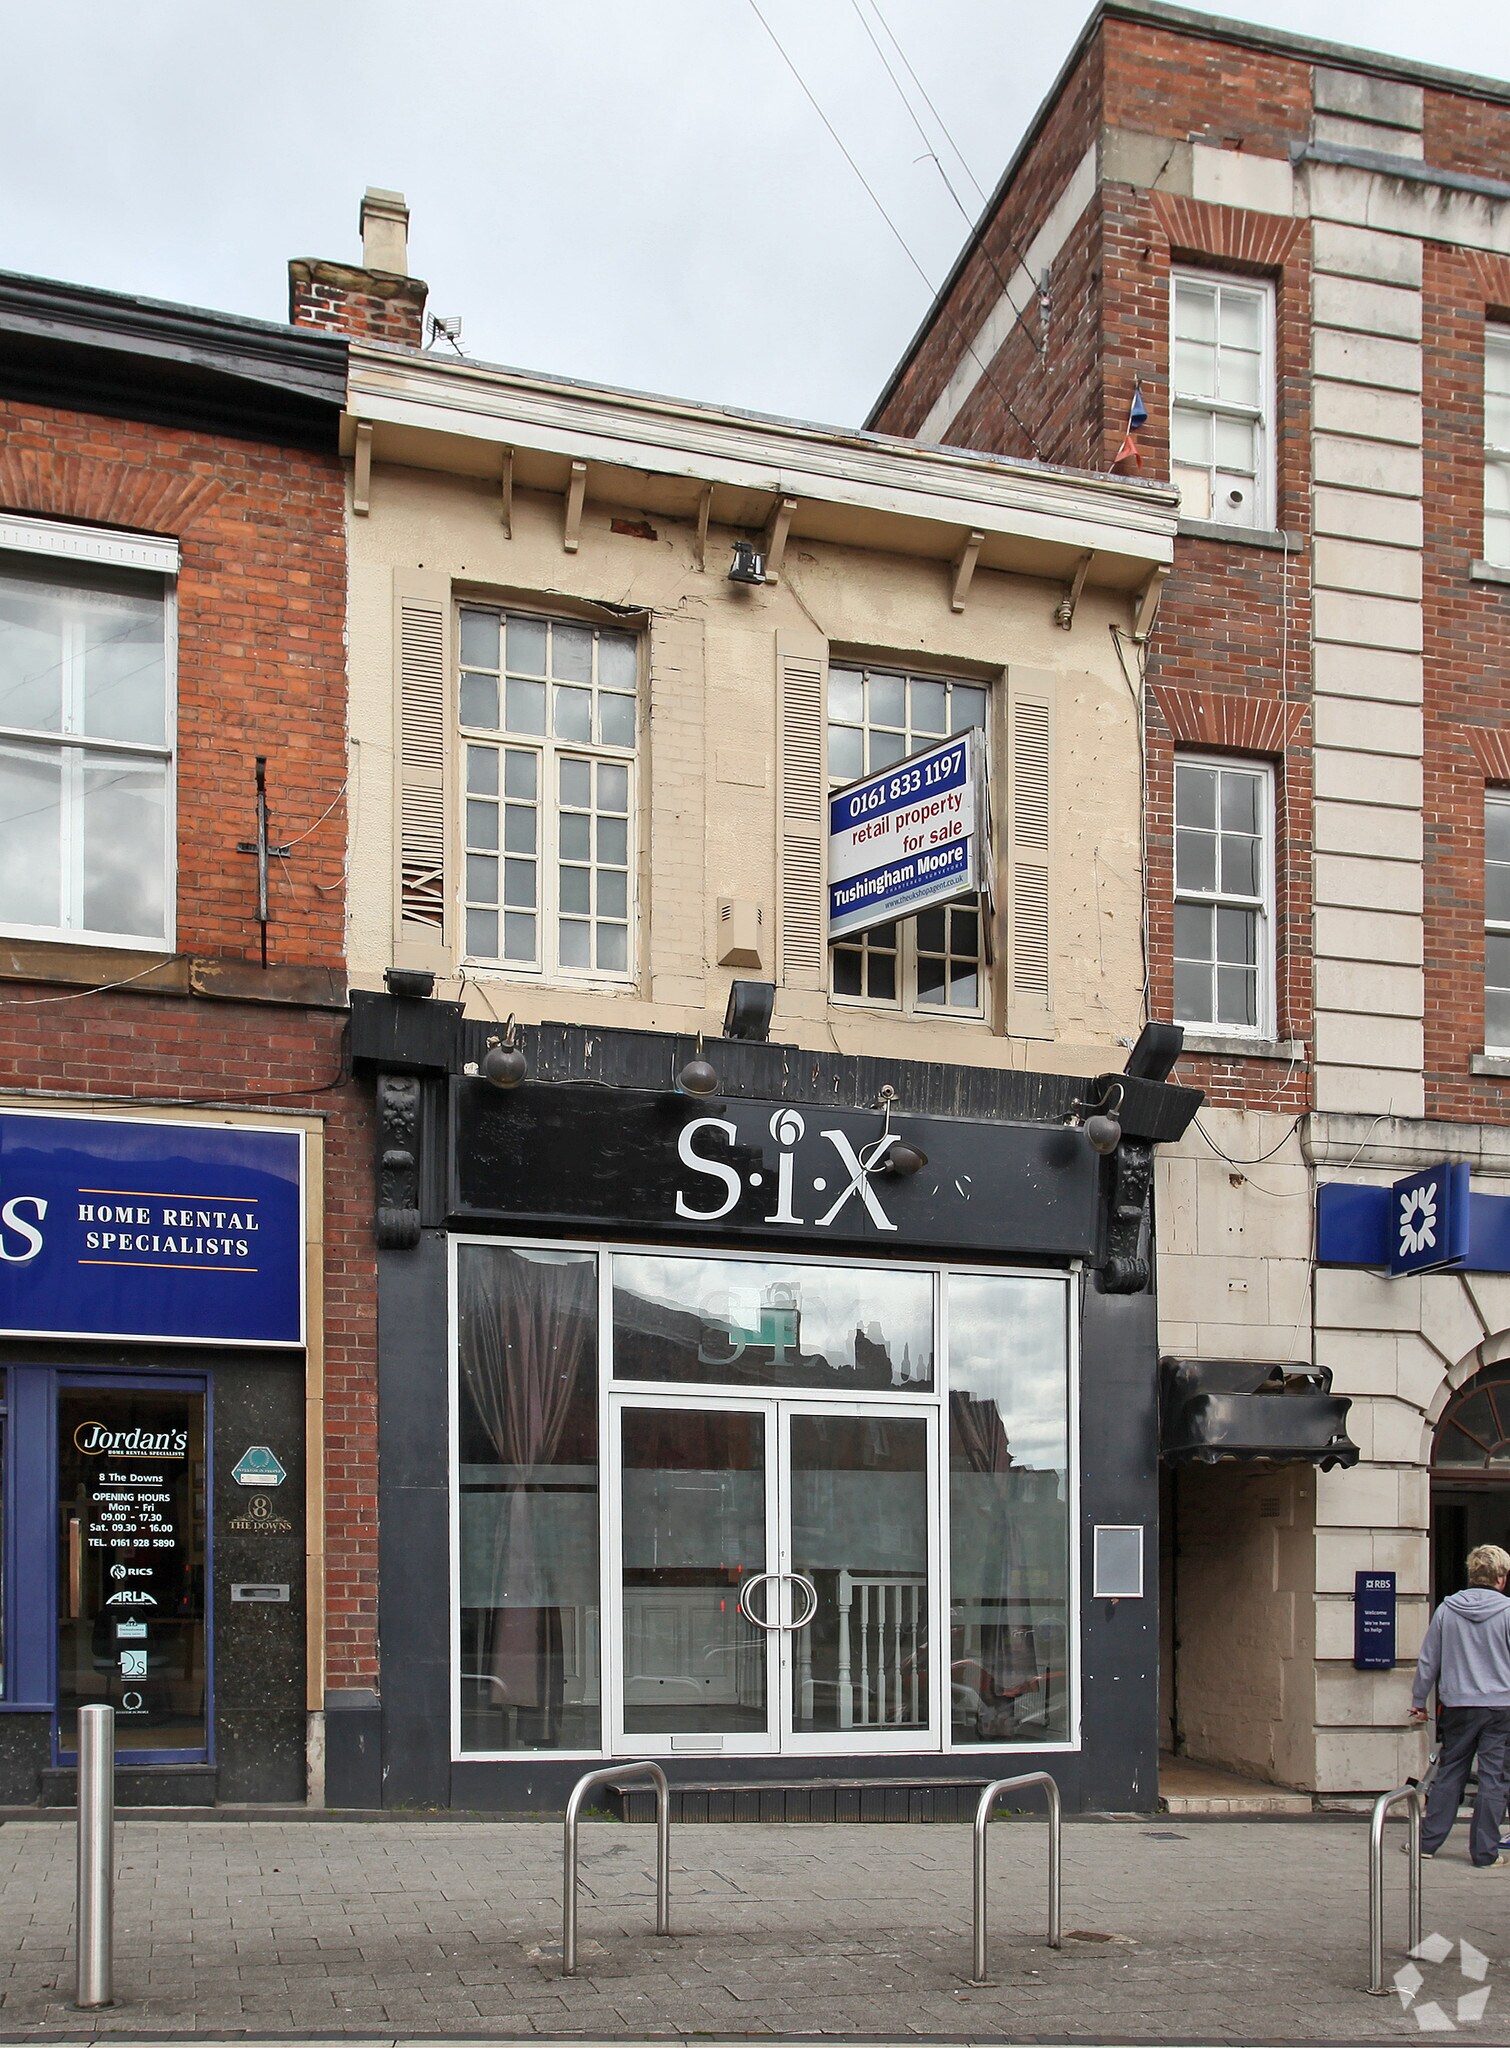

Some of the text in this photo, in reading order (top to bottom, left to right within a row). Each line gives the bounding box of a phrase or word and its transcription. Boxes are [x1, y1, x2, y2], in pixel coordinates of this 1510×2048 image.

[850, 750, 962, 817] 0161 833 1197
[852, 792, 962, 845] retail property
[903, 819, 962, 853] for sale
[834, 846, 963, 906] Tushingham Moore
[78, 1204, 259, 1230] HOME RENTAL
[86, 1232, 249, 1257] SPECIALISTS
[84, 1427, 187, 1450] Jordan's
[99, 1473, 163, 1482] 8 The Downs
[92, 1493, 170, 1502] OPENING HOURS
[108, 1503, 130, 1511] Mon
[143, 1504, 154, 1512] Fri
[253, 1497, 267, 1517] 8
[101, 1513, 126, 1521] 09.00
[139, 1513, 162, 1522] 17.30
[90, 1523, 108, 1532] Sat.
[112, 1524, 137, 1532] 09.30
[150, 1524, 173, 1532] 16.00
[229, 1521, 292, 1530] THE DOWNS
[88, 1538, 175, 1548] TEL. 0161 928 5890
[128, 1568, 153, 1576] RICS
[1374, 1579, 1391, 1589] RBS
[105, 1591, 158, 1605] ARLA
